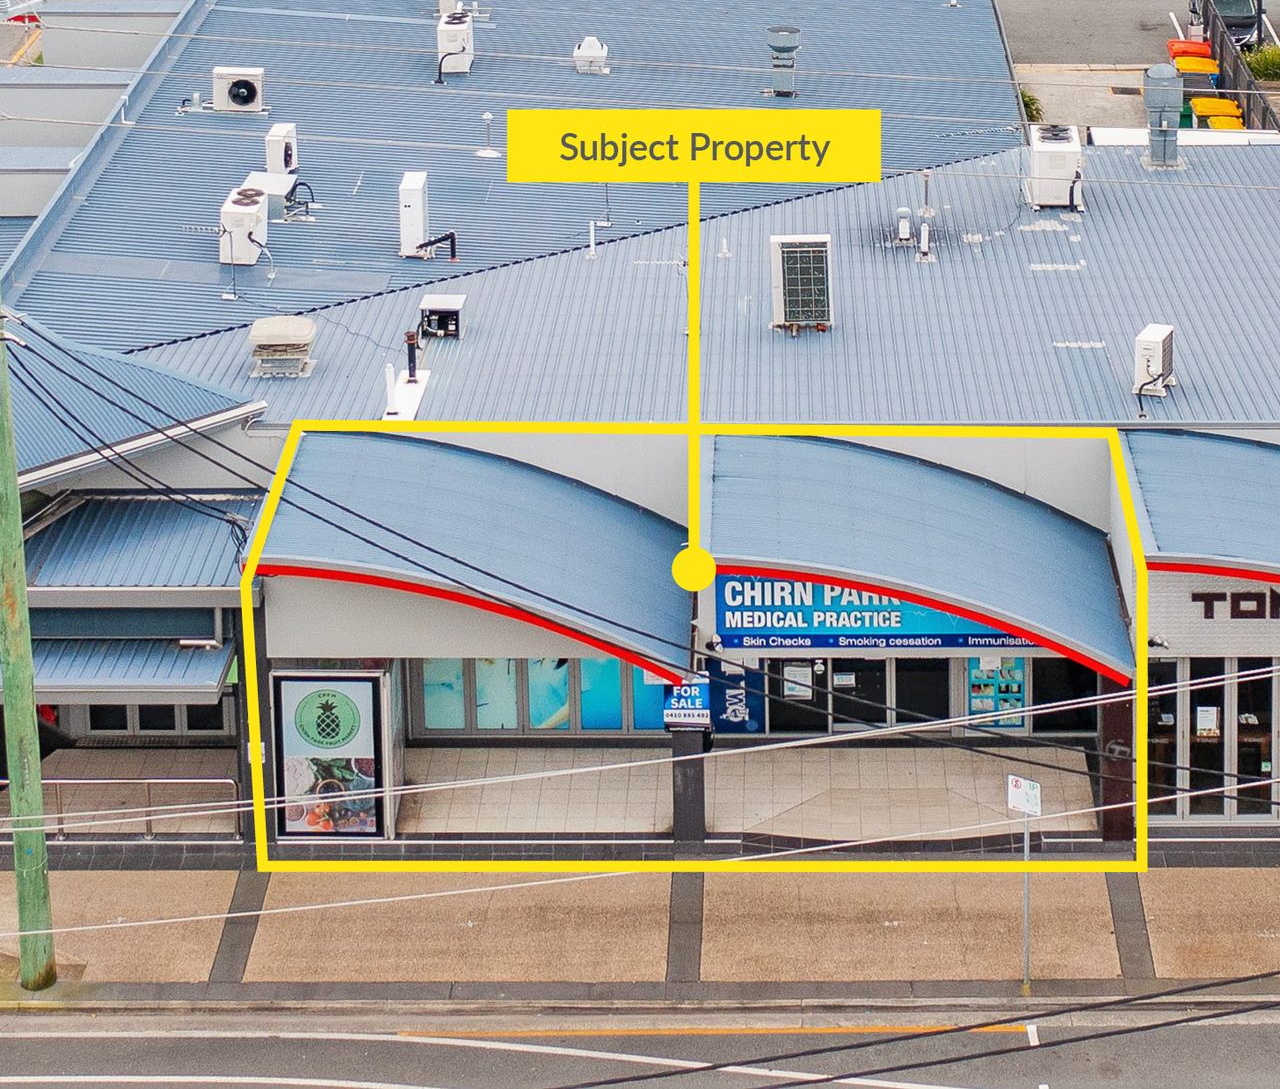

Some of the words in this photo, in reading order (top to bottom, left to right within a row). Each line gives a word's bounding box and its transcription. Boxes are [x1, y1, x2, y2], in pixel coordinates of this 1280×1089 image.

[724, 581, 813, 607] CHIRN
[725, 611, 808, 628] MEDICAL
[813, 611, 901, 628] PRACTICE
[742, 636, 767, 646] Skin
[768, 636, 811, 646] Checks
[838, 636, 886, 648] Smoking
[888, 636, 942, 646] cessation
[968, 636, 1038, 646] Immunisatio
[673, 686, 700, 697] FOR
[670, 698, 703, 709] SALE
